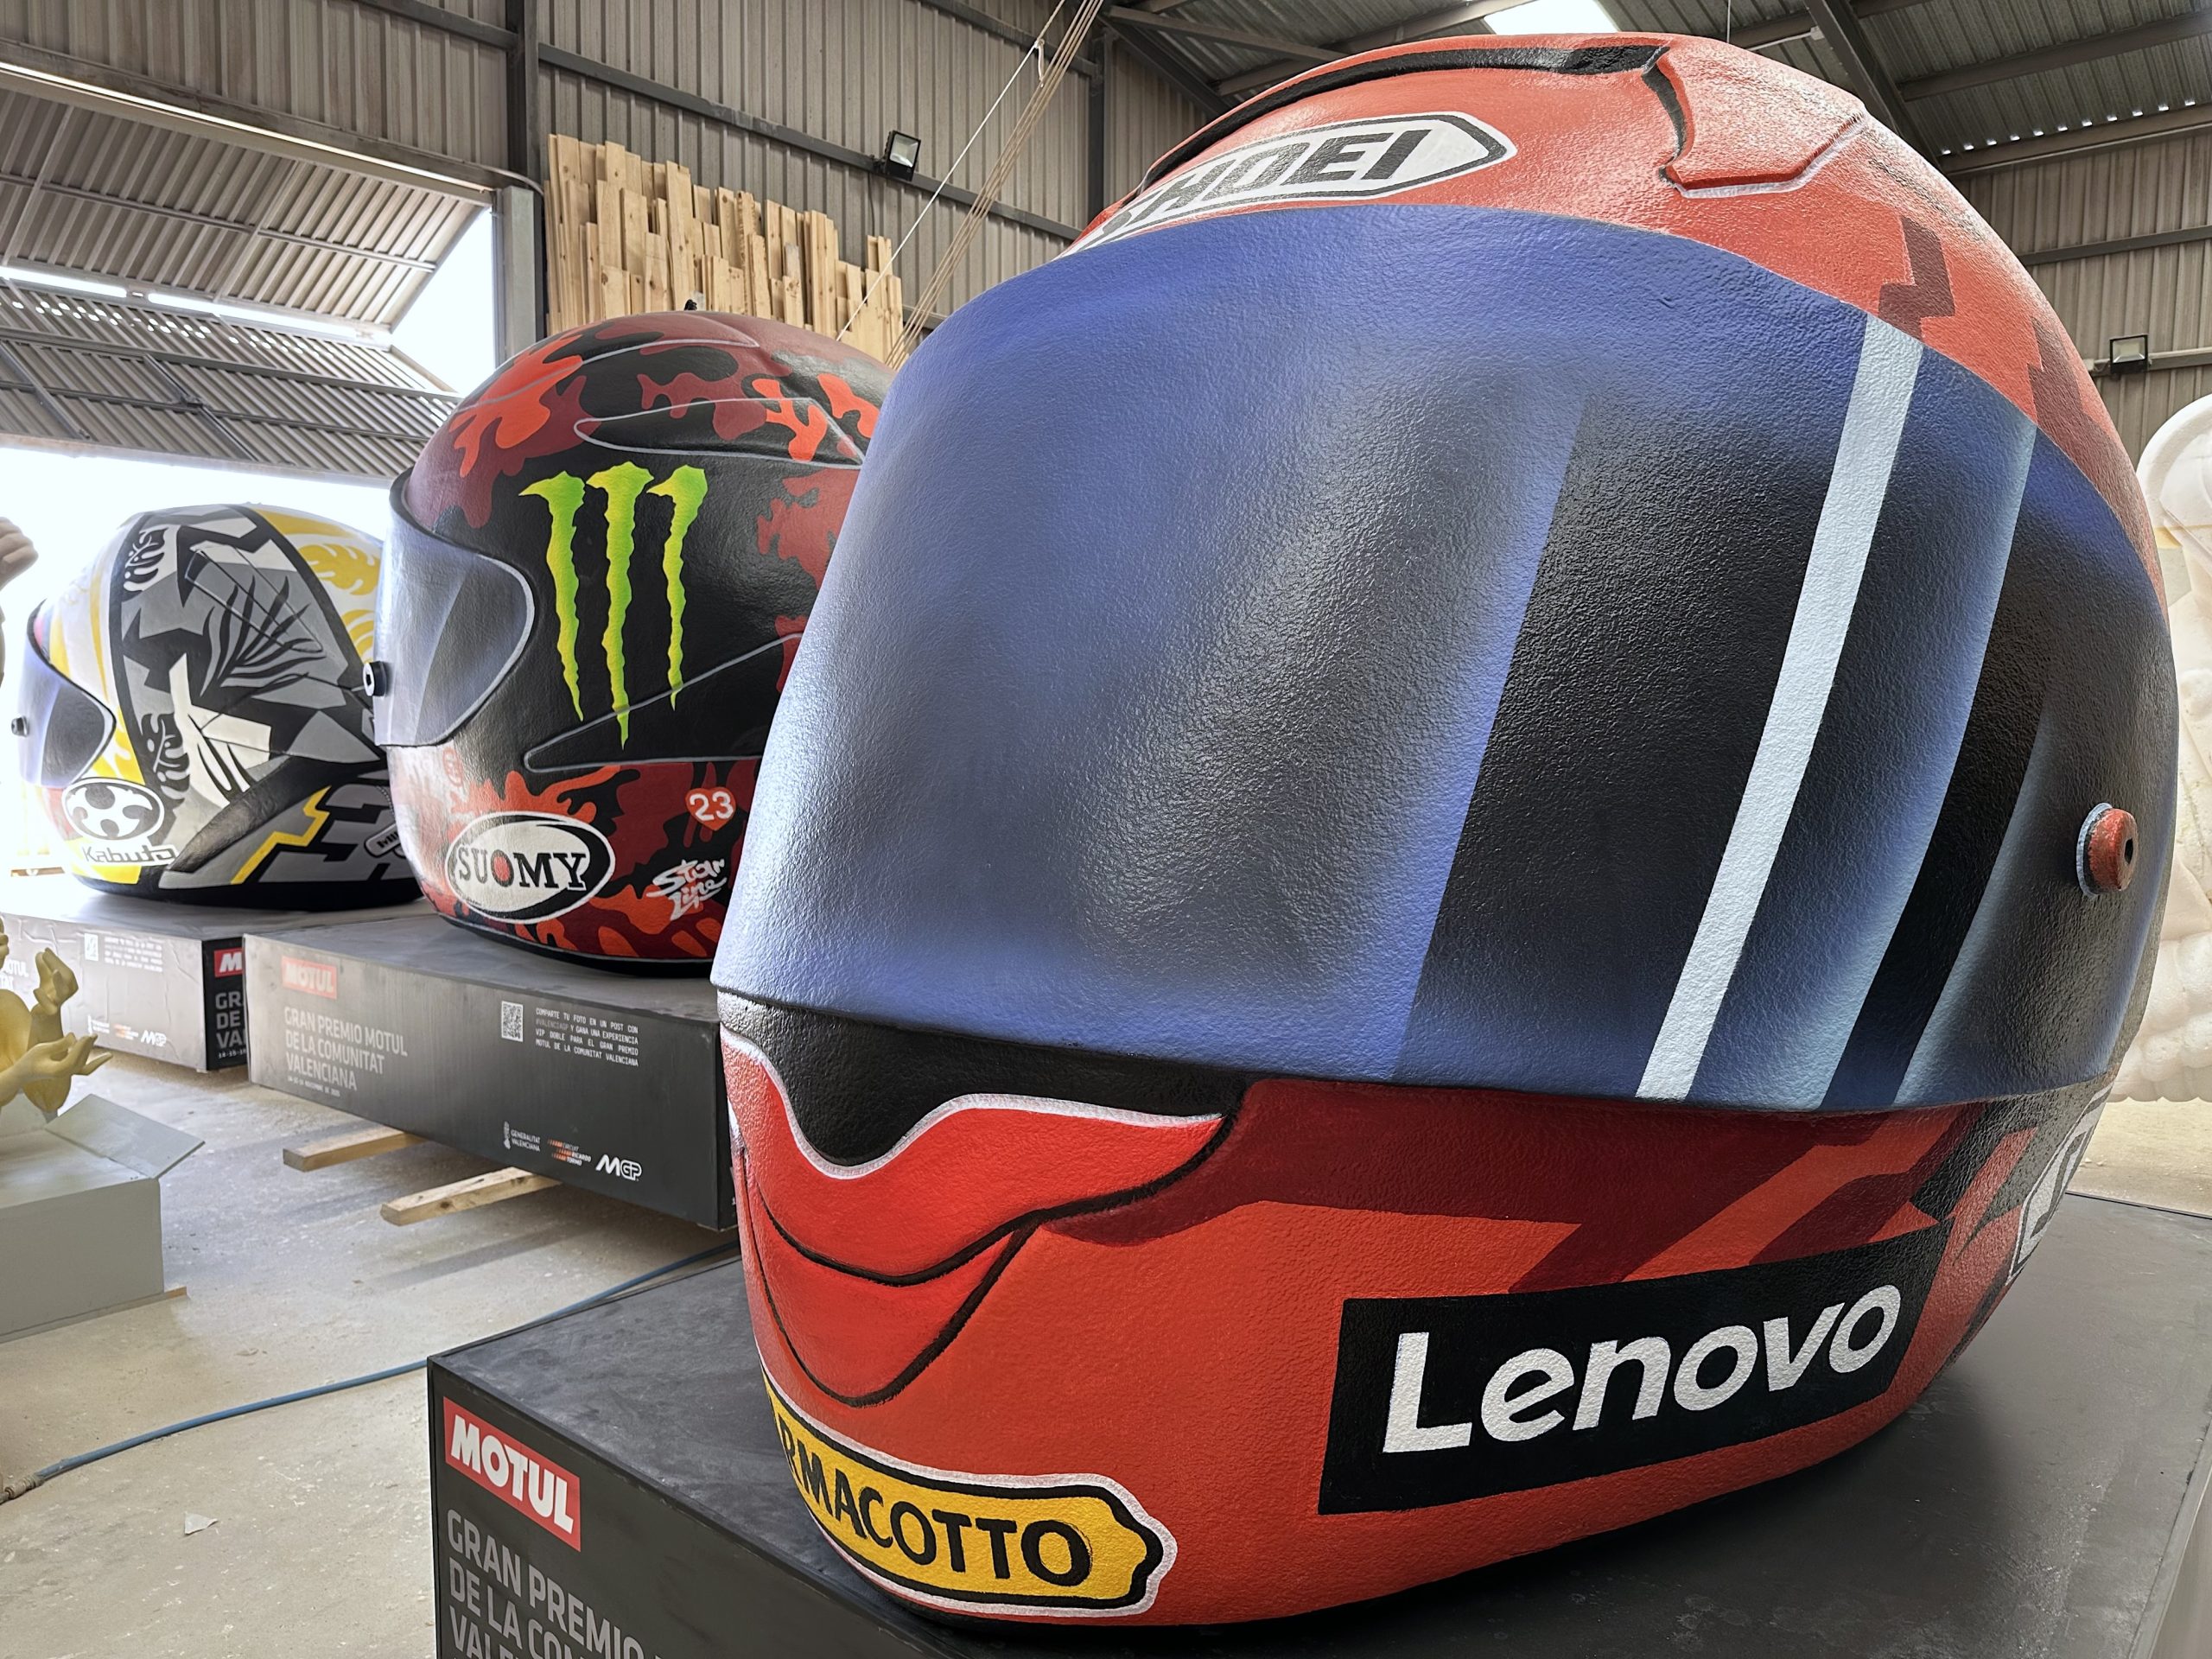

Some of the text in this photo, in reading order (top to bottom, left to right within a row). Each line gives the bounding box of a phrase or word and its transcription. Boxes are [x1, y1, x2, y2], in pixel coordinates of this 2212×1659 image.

[690, 791, 734, 821] 23
[82, 845, 176, 862] Kabuto
[456, 844, 587, 890] SUOMY
[286, 963, 334, 993] MOTUL
[215, 991, 244, 1009] GR
[216, 1010, 241, 1029] DE
[284, 1007, 408, 1057] GRAN PREMIO MOTUL
[536, 1007, 560, 1019] COMPARTE
[563, 1012, 570, 1020] TU
[574, 1014, 586, 1024] FOTO
[600, 1020, 607, 1028] UN
[610, 1021, 624, 1031] POST
[627, 1025, 638, 1033] CON
[216, 1030, 246, 1048] VA
[286, 1030, 385, 1075] DE LA COMUNITAT
[536, 1028, 638, 1056] VIP DOBLE PARA EL GRAN PREMIO
[536, 1039, 551, 1049] MOTUL
[555, 1042, 560, 1051] DE
[574, 1047, 602, 1059] COMUNITAT
[605, 1054, 639, 1066] VALENCIANA
[602, 1032, 638, 1046] EXPERIENCIA
[287, 1052, 358, 1091] VALENCIANA
[512, 1129, 541, 1143] GENERALITAT
[512, 1139, 541, 1152] VALENCIANA
[1383, 1285, 1901, 1452] Lenovo
[451, 1414, 574, 1535] MOTUL
[769, 1398, 1092, 1587] RMACOTTO
[448, 1509, 521, 1597] GRAN
[449, 1557, 480, 1617] DE
[487, 1585, 522, 1649] LA
